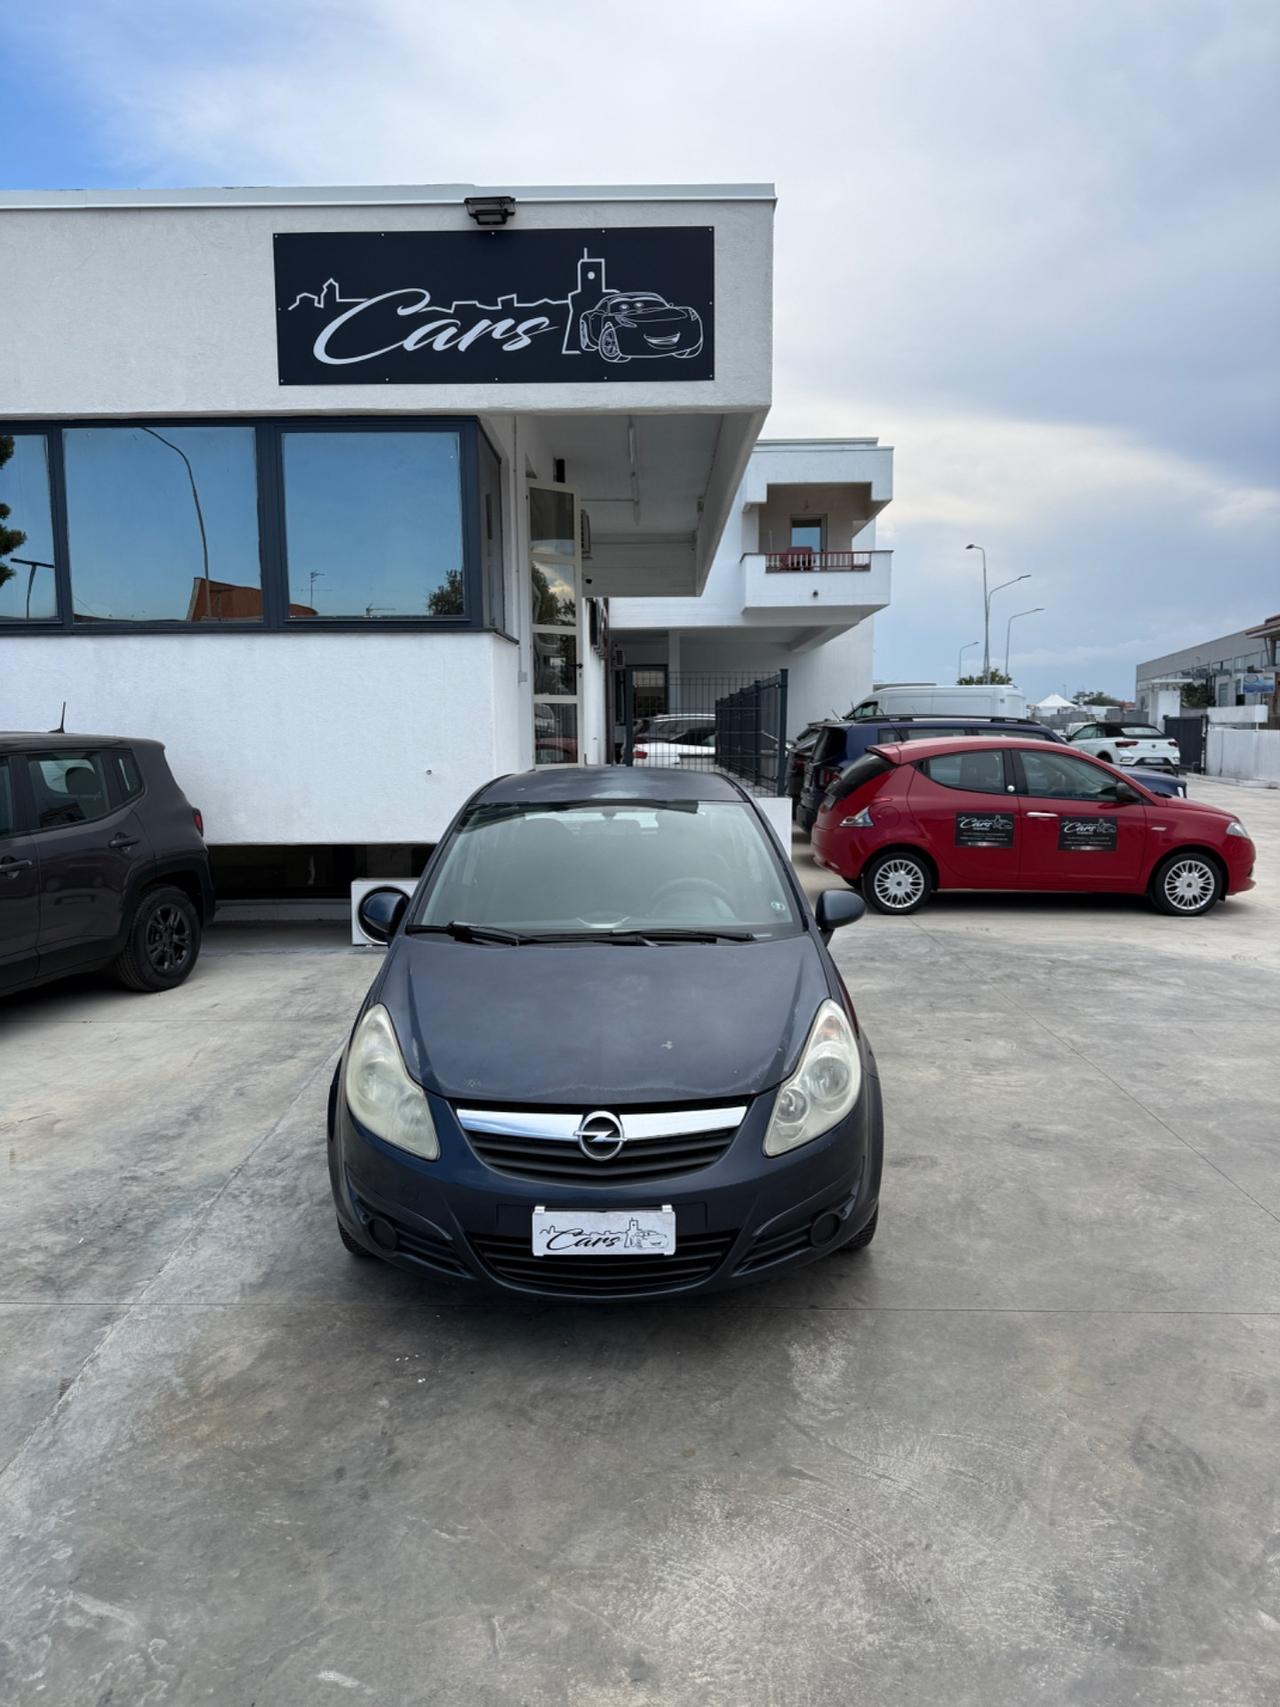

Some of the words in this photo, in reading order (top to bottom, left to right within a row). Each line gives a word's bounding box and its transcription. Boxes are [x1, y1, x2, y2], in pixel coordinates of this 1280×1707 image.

[312, 288, 559, 364] Cars
[959, 817, 993, 829] Cars
[1063, 821, 1097, 833] Cars
[546, 1227, 620, 1251] Cars
